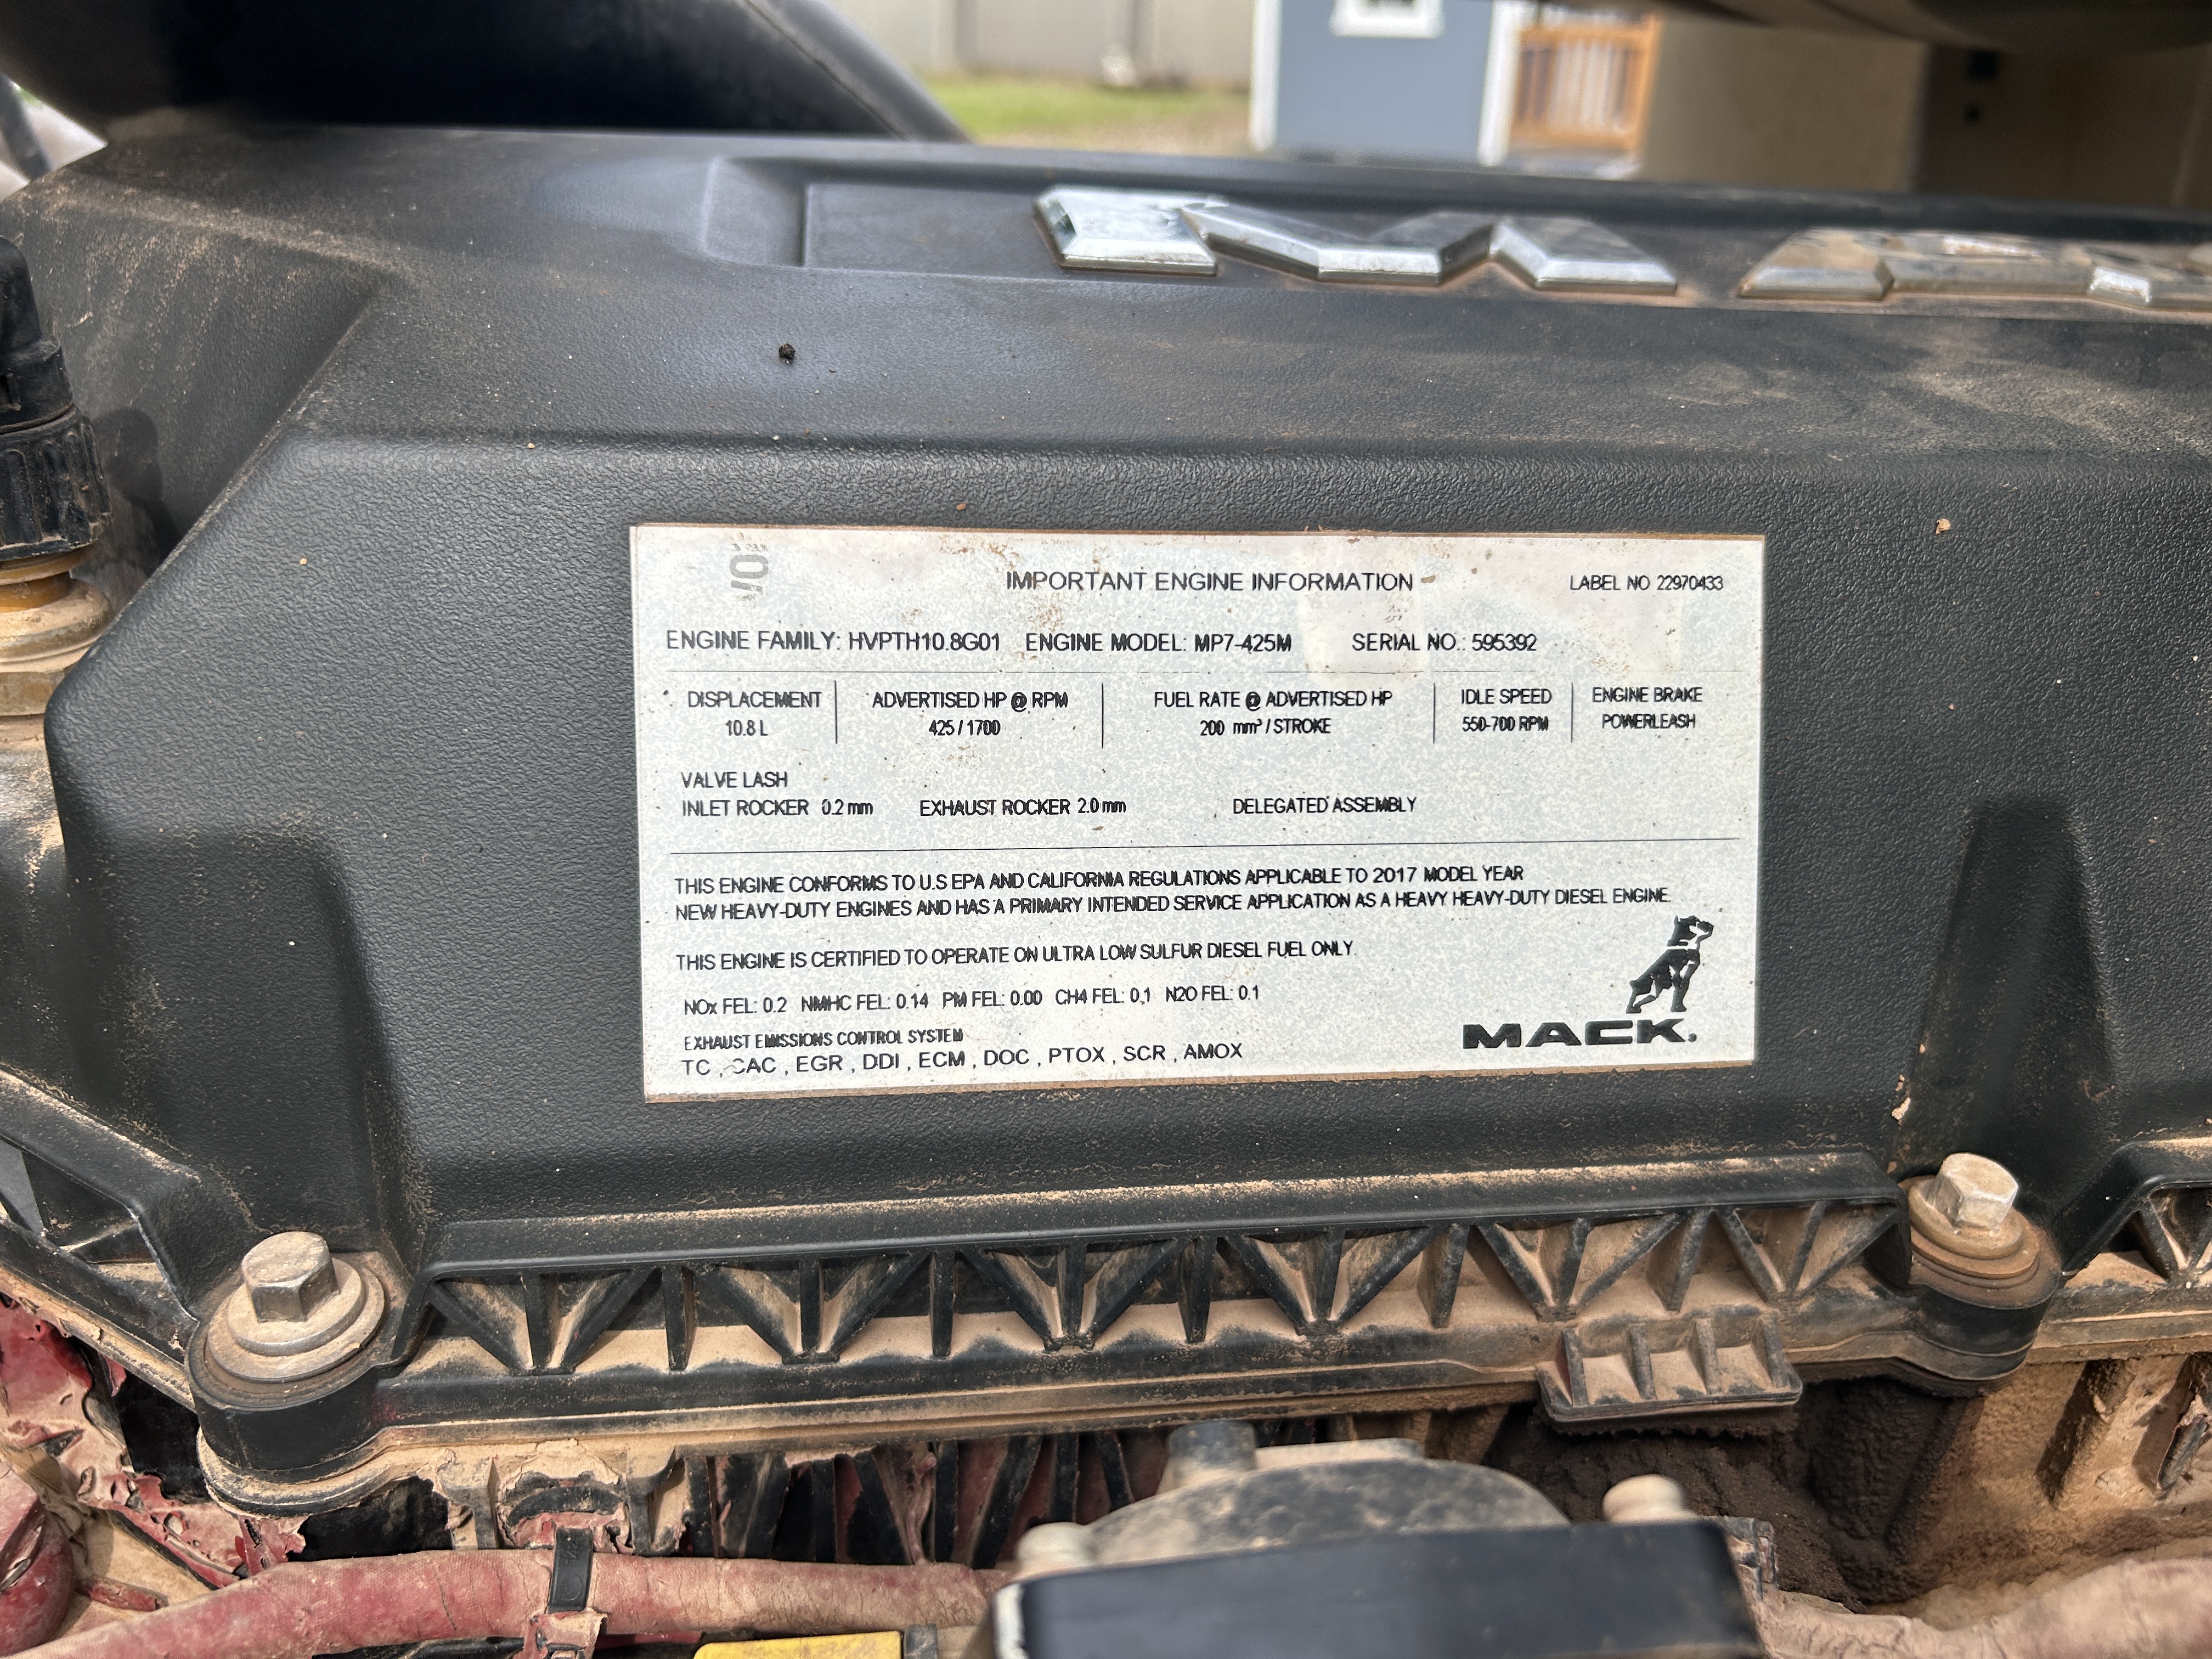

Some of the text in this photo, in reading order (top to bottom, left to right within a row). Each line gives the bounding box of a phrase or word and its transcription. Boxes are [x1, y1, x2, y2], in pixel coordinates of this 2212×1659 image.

[1007, 571, 1413, 591] IMPORTANT ENGINE INFORMATION
[1570, 574, 1724, 591] LABEL NO 22970433
[667, 630, 750, 650] ENGINE
[758, 630, 840, 650] FAMILY:
[849, 631, 1000, 651] HVPTH10.8G01
[1026, 633, 1103, 652] ENGINE
[1111, 633, 1187, 652] MODEL:
[1195, 634, 1291, 652] MP7-425M
[1351, 633, 1420, 651] SERIAL
[1472, 633, 1537, 651] 595392
[688, 691, 823, 708] DISPLACEMENT
[872, 691, 980, 708] ADVERTISED
[984, 691, 1007, 708] HP
[1032, 691, 1068, 708] RPM
[1154, 691, 1194, 708] FUEL
[1199, 691, 1240, 708] RATE
[1265, 690, 1367, 707] ADVERTISED
[1371, 690, 1393, 707] HP
[1461, 688, 1553, 705] IDLE SPEED
[1592, 687, 1703, 703] ENGINE BRAKE
[726, 719, 769, 736] 10.8 L
[1200, 720, 1225, 736] 200
[1462, 715, 1549, 732] 550-700 RPM
[1602, 713, 1696, 729] POWERLEASH
[681, 771, 788, 788] VALVE LASH
[683, 799, 873, 817] INLET ROCKER 0.2 mm
[920, 797, 1126, 816] EXHAUST ROCKER 2.0 mm
[1233, 795, 1417, 814] DELEGATED ASSEMBLY
[674, 878, 714, 895] THIS
[719, 876, 785, 894] ENGINE
[789, 874, 889, 893] CONFORMS
[891, 874, 916, 891] TO
[952, 873, 985, 890] EPA
[989, 872, 1024, 889] AND
[1028, 871, 1125, 889] CALIFORNIA
[1128, 869, 1241, 887] REGULATIONS
[1244, 867, 1341, 885] APPLICABLE
[1345, 867, 1368, 883] TO
[1373, 867, 1418, 883] 2017
[1424, 866, 1478, 882] MODEL
[1482, 864, 1524, 882] YEAR
[676, 887, 1671, 921] NEW HEAVY-DUTY ENGINES AND HAS A PRIMARY INTENDED SERVICE APPLICATION AS A HEAVY HEAVY-DUTY DIESEL ENGINE
[676, 940, 1353, 970] THIS ENGINE IS CERTIFIED TO OPERATE ON ULTRA LOW SULFUR DIESEL FUEL ONLY
[723, 997, 757, 1014] FEL:
[763, 996, 787, 1013] 0.2
[802, 995, 852, 1012] NMHC
[856, 994, 891, 1011] FEL:
[896, 992, 929, 1009] 0.14
[942, 991, 967, 1009] PM
[972, 990, 1005, 1007] FEL:
[1010, 989, 1043, 1006] 0.00
[1055, 989, 1087, 1005] CH4
[1092, 988, 1125, 1004] FEL:
[1130, 986, 1150, 1005] 0.1
[1201, 985, 1233, 1001] FEL:
[1238, 984, 1259, 1001] 0.1
[684, 1028, 964, 1051] EXHAUST EMISSIONS CONTROL SYSTEM
